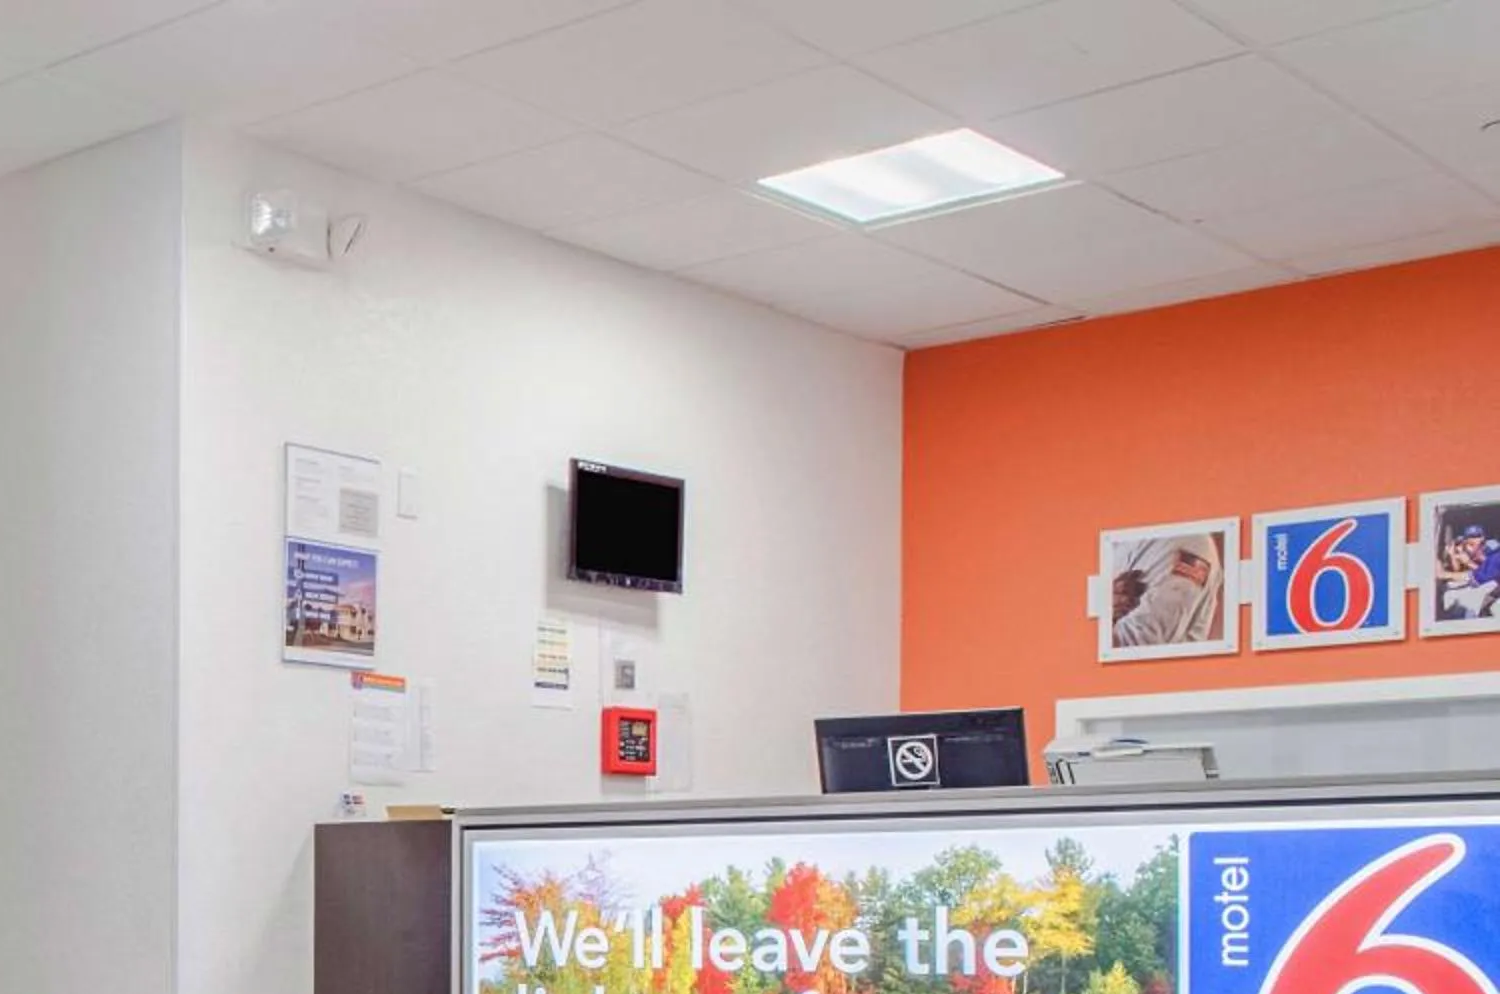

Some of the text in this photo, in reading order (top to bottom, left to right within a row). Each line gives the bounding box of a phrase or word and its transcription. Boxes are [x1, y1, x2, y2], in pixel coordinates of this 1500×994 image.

[1287, 518, 1375, 635] 6
[514, 906, 1030, 977] We'll leave the
[1212, 856, 1250, 967] motel
